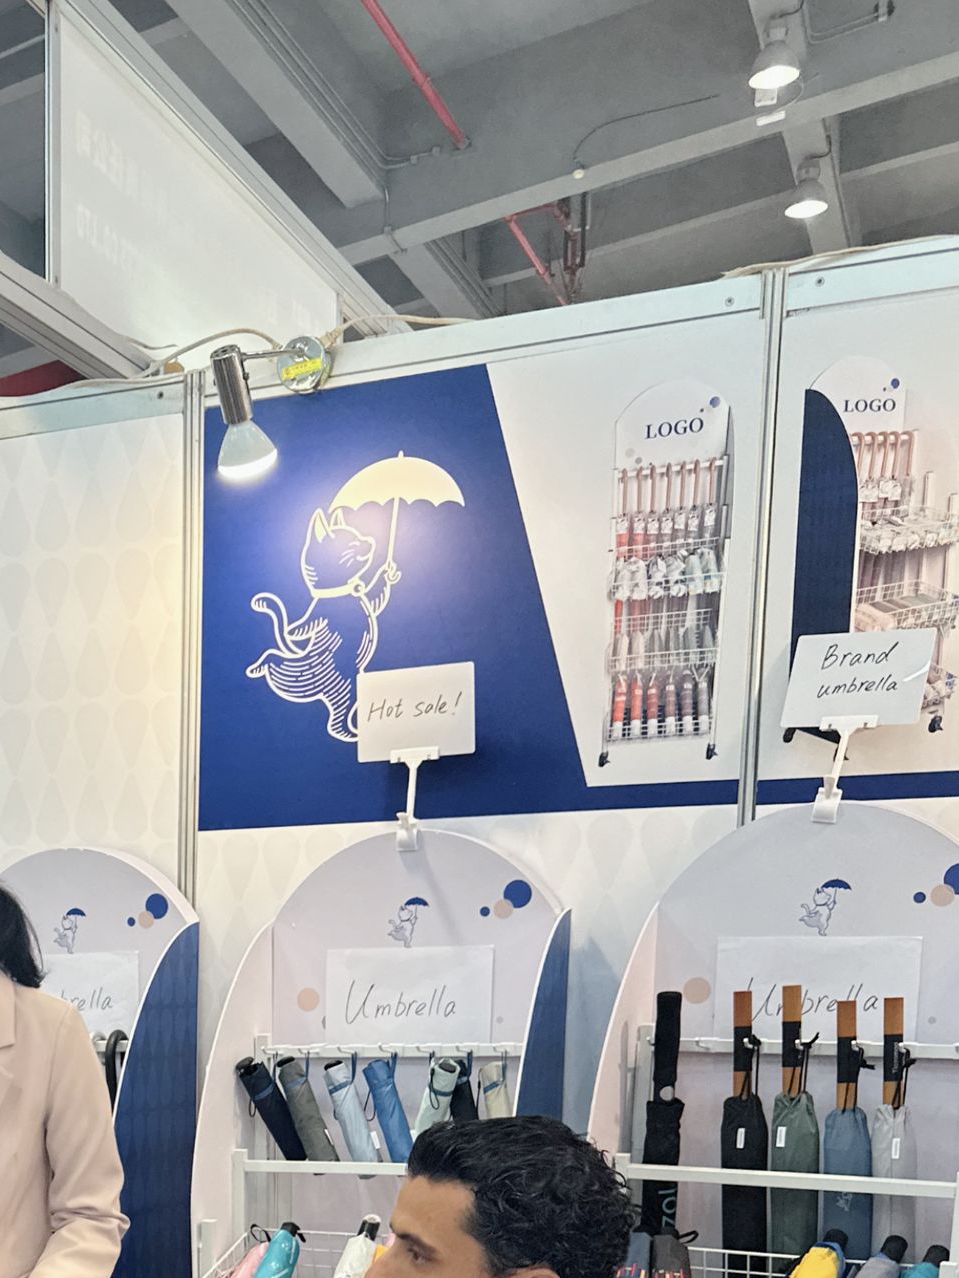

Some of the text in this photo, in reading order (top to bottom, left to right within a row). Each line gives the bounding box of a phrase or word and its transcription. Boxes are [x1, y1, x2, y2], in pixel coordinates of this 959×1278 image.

[844, 398, 896, 414] LOGO
[644, 417, 704, 440] LOGO
[821, 641, 900, 670] Brand
[816, 674, 898, 699] umbrella
[367, 691, 463, 722] Hot sale!
[345, 979, 457, 1025] Umbrella
